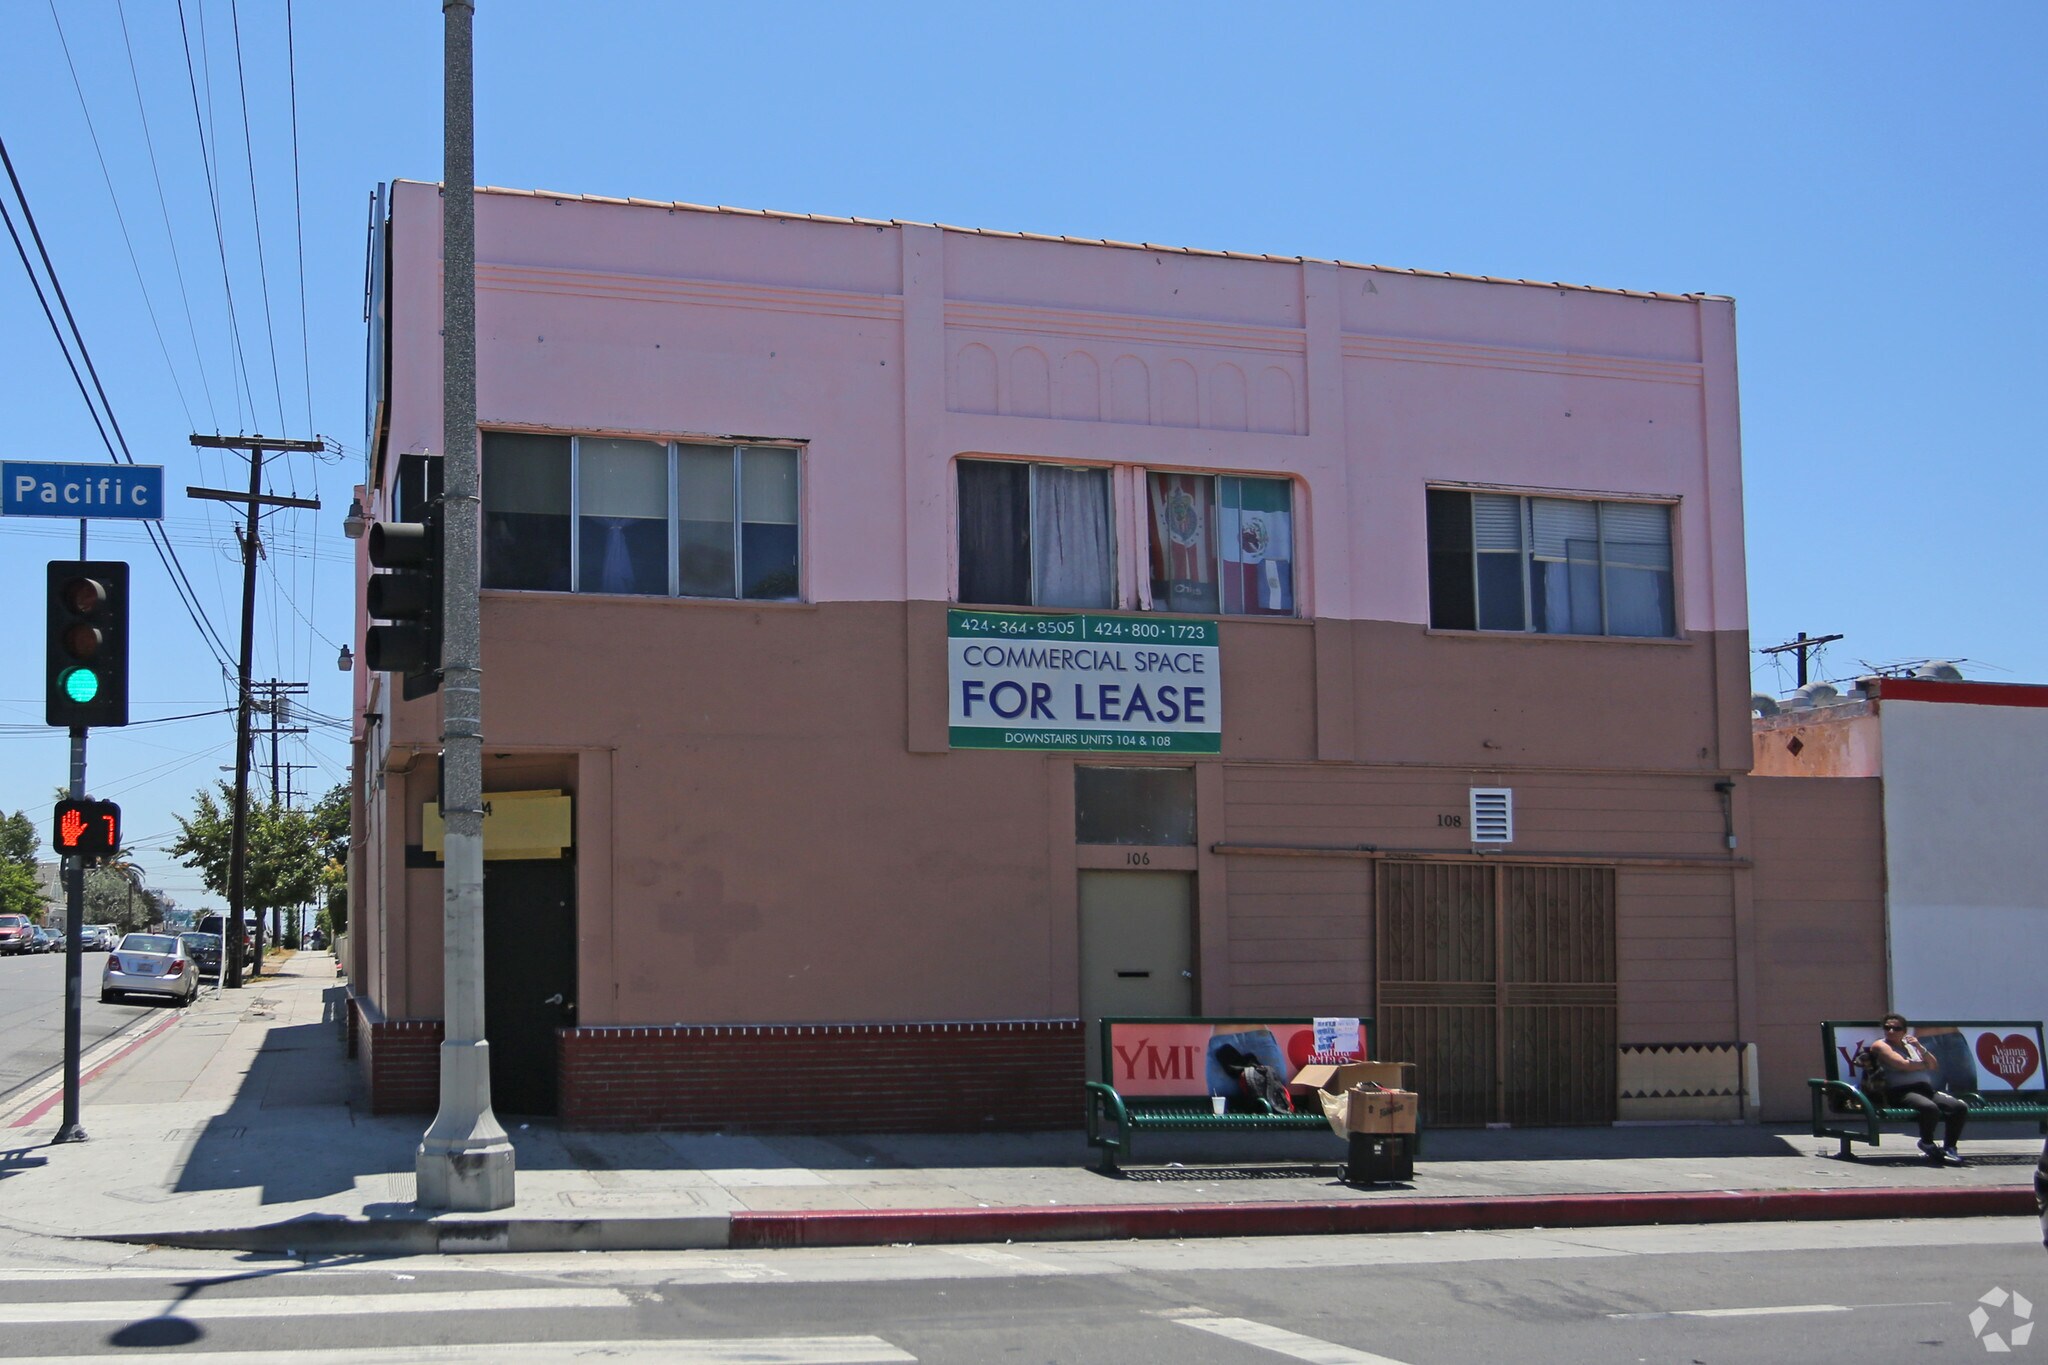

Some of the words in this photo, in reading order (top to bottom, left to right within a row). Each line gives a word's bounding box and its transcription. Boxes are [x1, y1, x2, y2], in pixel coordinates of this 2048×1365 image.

[16, 475, 148, 506] Pacific
[963, 645, 1127, 671] COMMERCIAL
[1134, 651, 1205, 674] SPACE
[962, 680, 1057, 720] FOR
[1075, 683, 1205, 723] LEASE
[1005, 732, 1078, 745] DOWNSTAIRS
[1080, 734, 1113, 746] UNITS
[1116, 735, 1136, 746] 104
[1139, 736, 1147, 746] &
[1151, 736, 1171, 747] 108
[102, 814, 114, 846] 7
[1437, 813, 1462, 828] 108
[1126, 852, 1150, 866] 106
